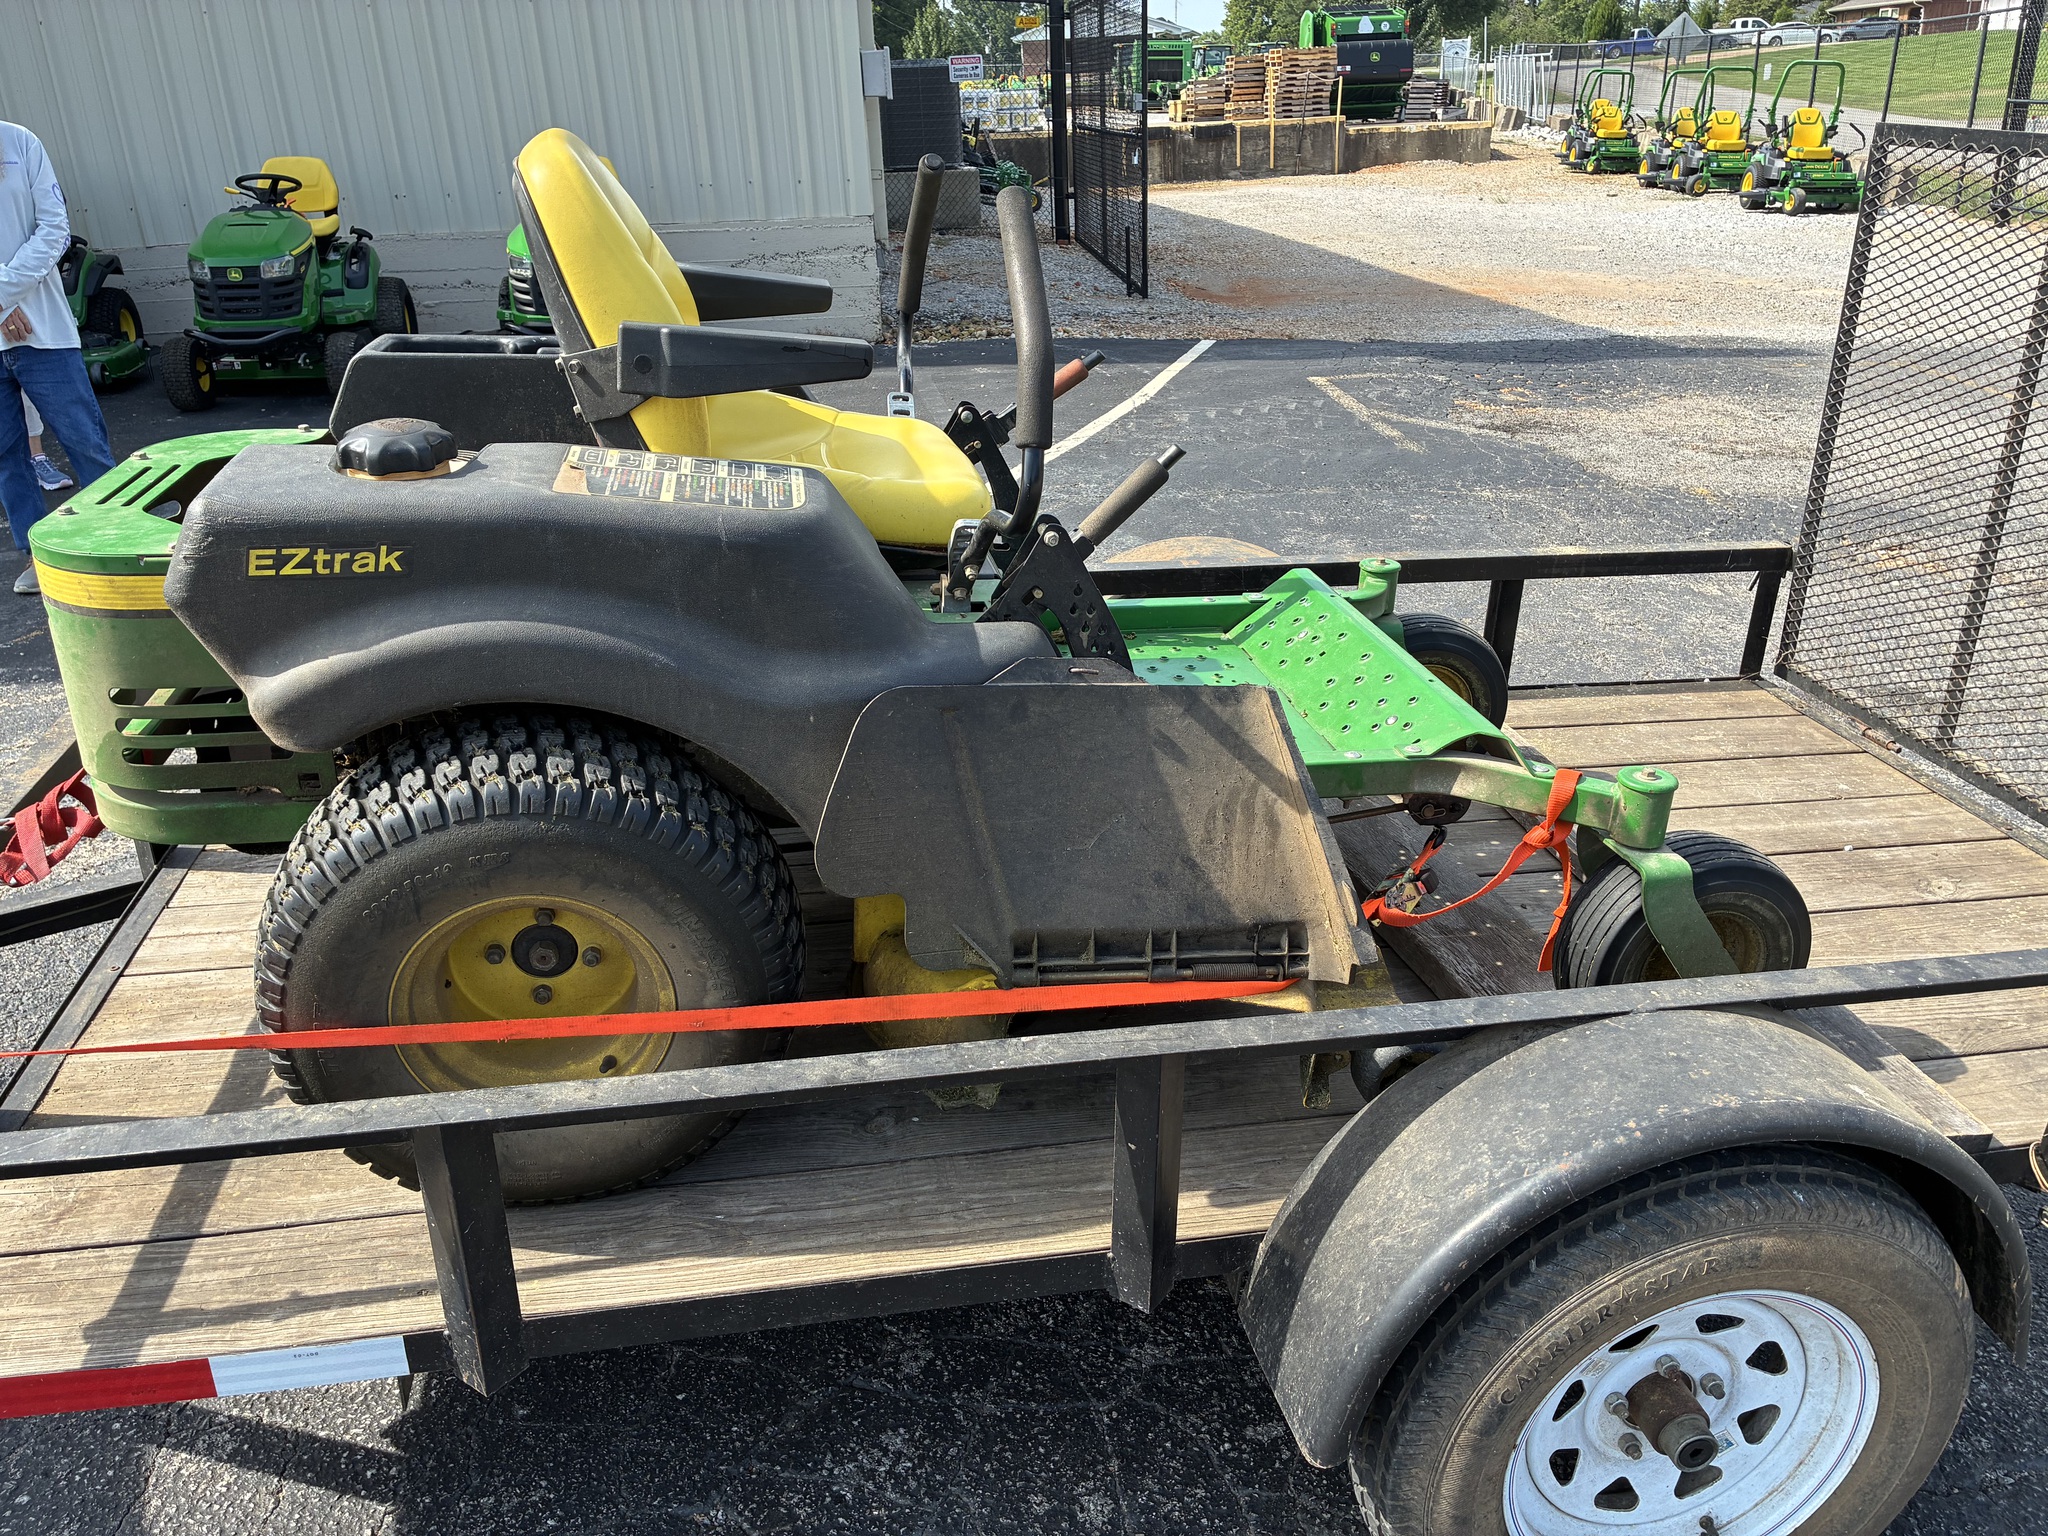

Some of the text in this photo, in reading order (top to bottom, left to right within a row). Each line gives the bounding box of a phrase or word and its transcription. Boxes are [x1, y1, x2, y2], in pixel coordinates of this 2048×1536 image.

[248, 545, 404, 577] EZtrak
[1499, 1257, 1721, 1406] CARRIER STAR
